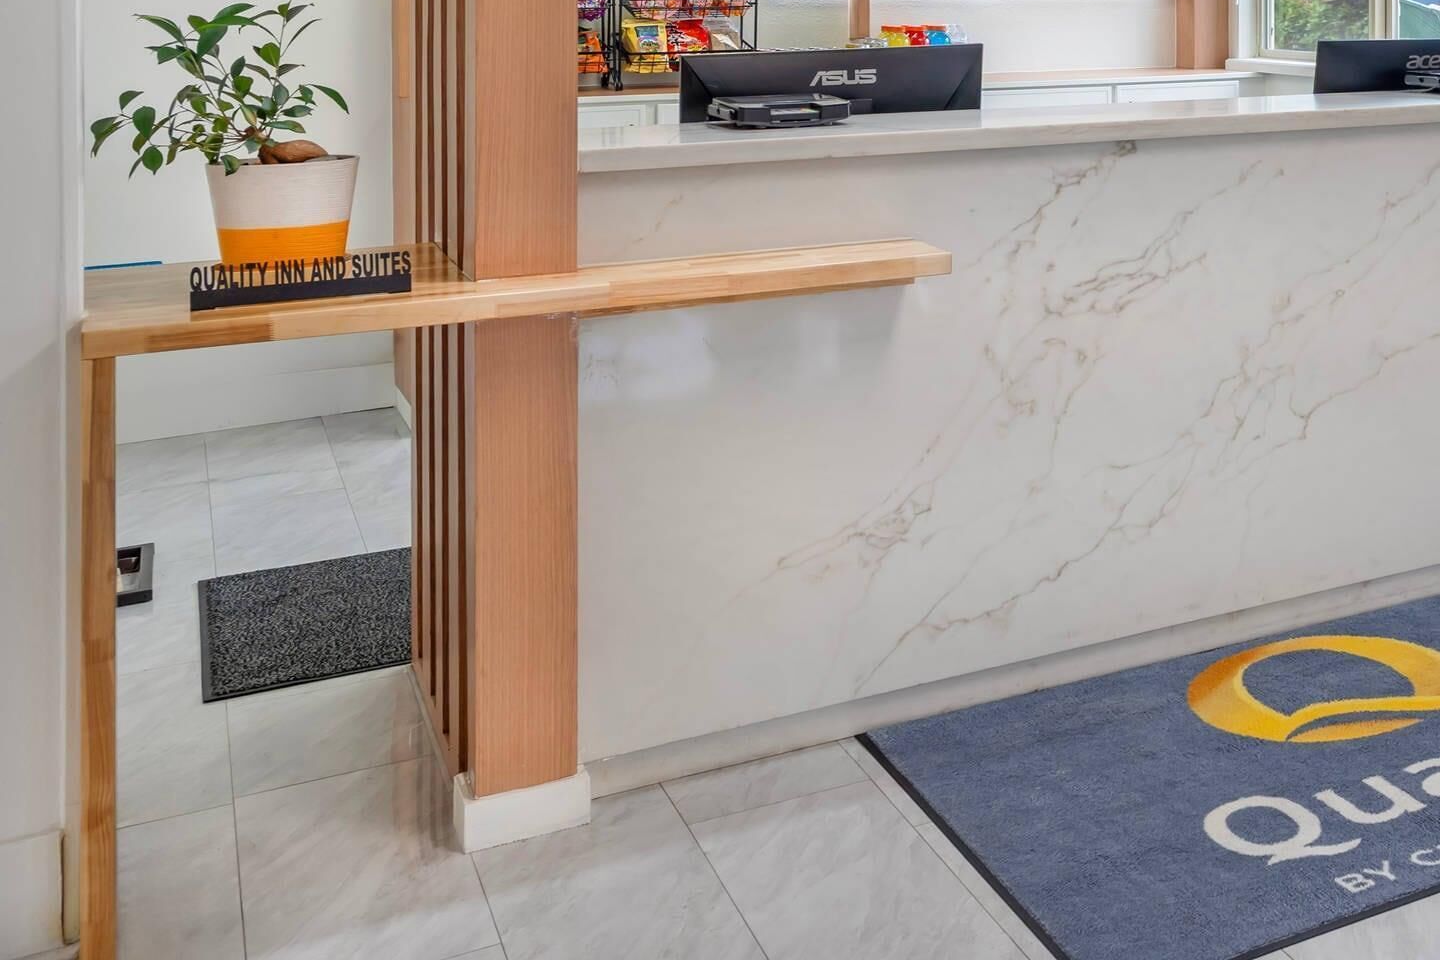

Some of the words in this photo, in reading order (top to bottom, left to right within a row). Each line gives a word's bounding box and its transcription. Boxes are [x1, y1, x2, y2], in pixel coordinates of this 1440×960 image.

[809, 68, 878, 87] ASUS
[190, 261, 267, 292] QUALITY
[275, 259, 305, 285] INN
[311, 256, 346, 282] AND
[352, 251, 411, 279] SUITES
[1334, 860, 1398, 895] BY
